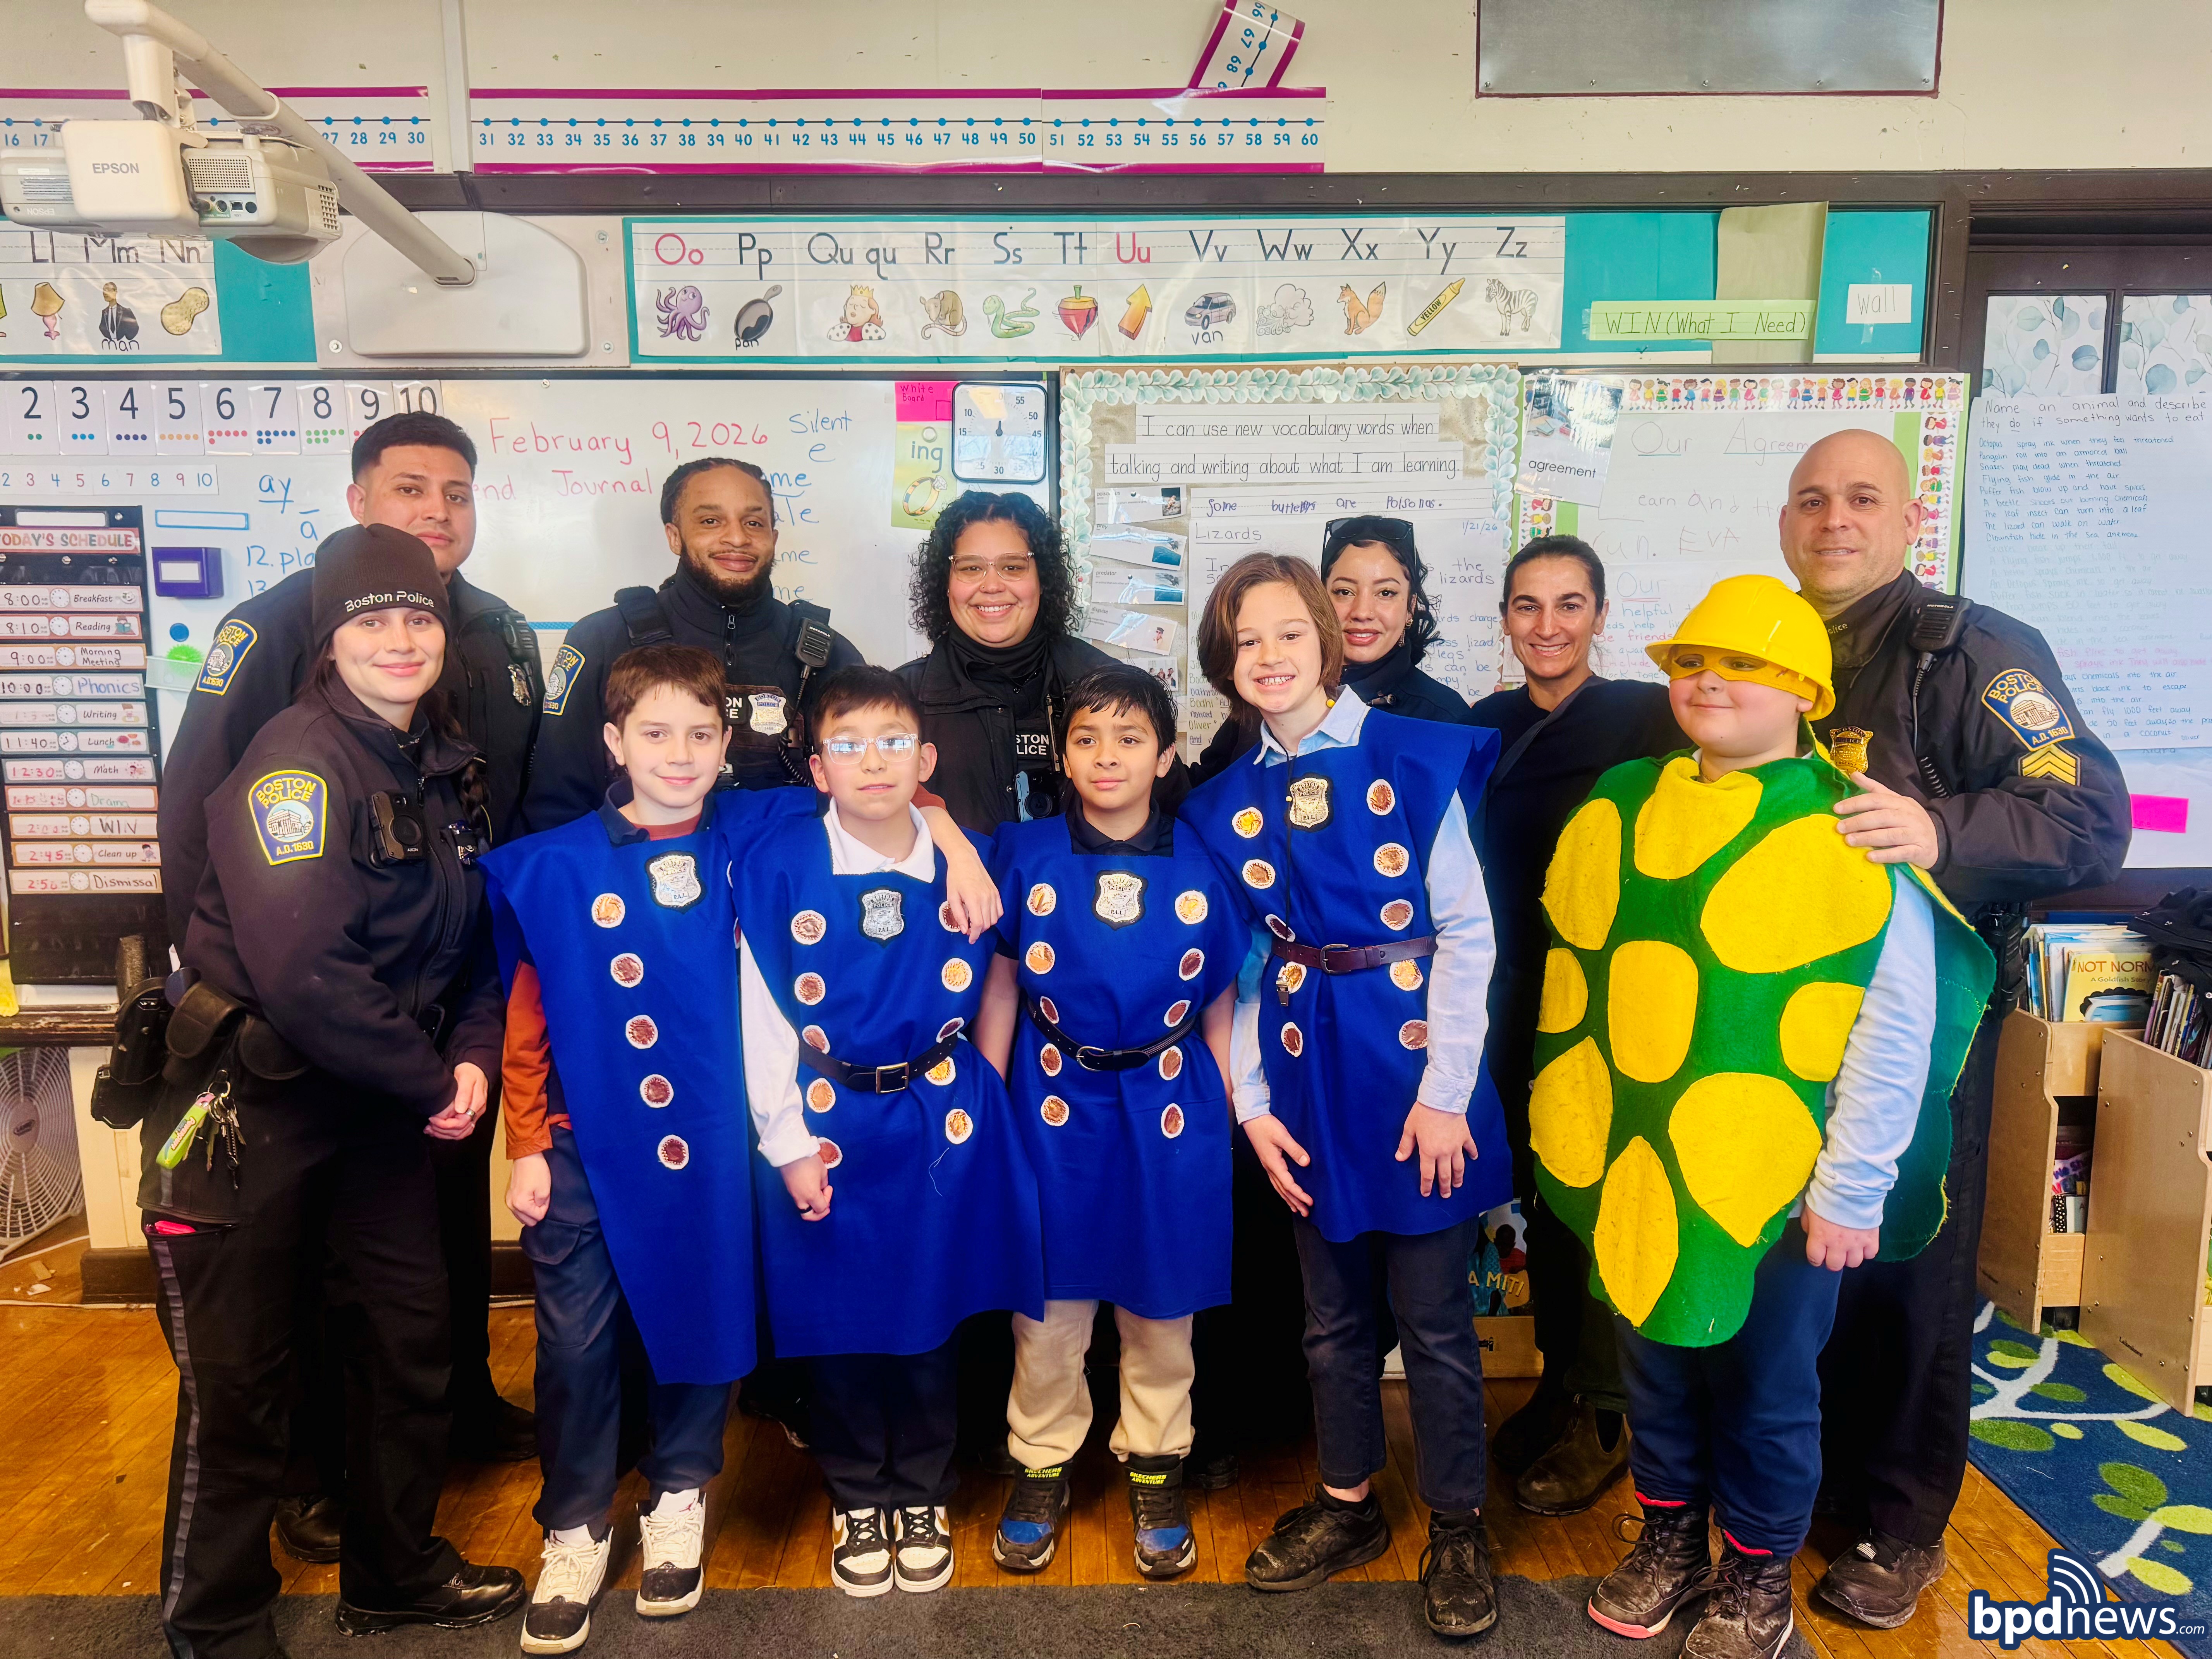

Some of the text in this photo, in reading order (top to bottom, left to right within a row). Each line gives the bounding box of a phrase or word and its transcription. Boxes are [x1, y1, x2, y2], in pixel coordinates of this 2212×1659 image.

[6, 132, 425, 146] 16 17 28 29 30
[1051, 133, 1178, 146] 51 52 53 54 55
[92, 163, 140, 173] EPSON
[655, 233, 704, 265] Oo
[738, 232, 773, 280] Pp
[925, 232, 955, 264] Rr
[993, 232, 1023, 264] Ss
[1053, 232, 1087, 264] Tt
[1116, 232, 1151, 264] Uu
[1188, 229, 1228, 263] Vv
[1257, 229, 1313, 261] Ww
[1341, 227, 1379, 261] Xx
[1417, 227, 1457, 275] Yy
[1496, 227, 1528, 259] Zz
[1419, 298, 1443, 322] YELLOW
[1720, 312, 1740, 333] I
[1755, 311, 1806, 335] Need)
[1191, 329, 1223, 344] van
[101, 338, 140, 352] man
[735, 338, 759, 351] pan
[22, 386, 438, 419] 2 3 4 5 6 7 8 9 10
[903, 393, 924, 402] Board
[1015, 397, 1025, 405] 55
[1985, 396, 2206, 414] Name animal and describe
[964, 409, 972, 417] 10
[1029, 412, 1038, 420] 50
[789, 408, 852, 433] Silent
[1980, 411, 2204, 433] they something wants eat
[959, 428, 967, 436] 15
[1142, 414, 1434, 442] I can use new vocabulary words when
[490, 417, 632, 464] February
[1632, 421, 1693, 454] Our
[1979, 437, 2037, 450] Octopus spray
[911, 441, 943, 473] ing
[1979, 451, 2008, 462] Pangolin
[994, 466, 1004, 474] 30
[1111, 452, 1460, 482] talking and writing about what I am learning.
[1528, 459, 1596, 481] agreement
[2013, 464, 2028, 472] play
[551, 469, 653, 496] Journal
[1982, 475, 2011, 486] Flying
[1196, 522, 1262, 541] Lizards
[1462, 520, 1498, 536] 1/21/26
[0, 533, 133, 547] ODAY'S SCHEDULE
[1452, 557, 1484, 571] the
[1440, 572, 1494, 584] lizards
[1617, 572, 1667, 598] Our
[4, 593, 113, 606] 8:00 Breakfast
[345, 591, 435, 612] Boston Police
[1621, 603, 1673, 620] helpful
[76, 622, 110, 633] Reading
[1469, 614, 1498, 629] change
[1633, 621, 1655, 632] help
[1468, 635, 1494, 647] lizard
[11, 646, 121, 666] 9:00 Morning
[77, 677, 140, 695] Phonics
[1997, 681, 2045, 704] POLICE
[83, 710, 117, 720] Writing
[2124, 706, 2141, 714] 1000
[6, 737, 115, 749] 11:40 Lunch
[256, 777, 317, 802] BOSTON
[261, 788, 313, 809] POLICE
[99, 817, 137, 835] WIN
[98, 850, 137, 860] Clean up
[93, 874, 158, 890] Dismissal
[2078, 961, 2107, 973] NOT
[1487, 1271, 1525, 1297] MITI
[1129, 1471, 1167, 1480] SKECHERS
[1131, 1477, 1165, 1486] ADVENTURE
